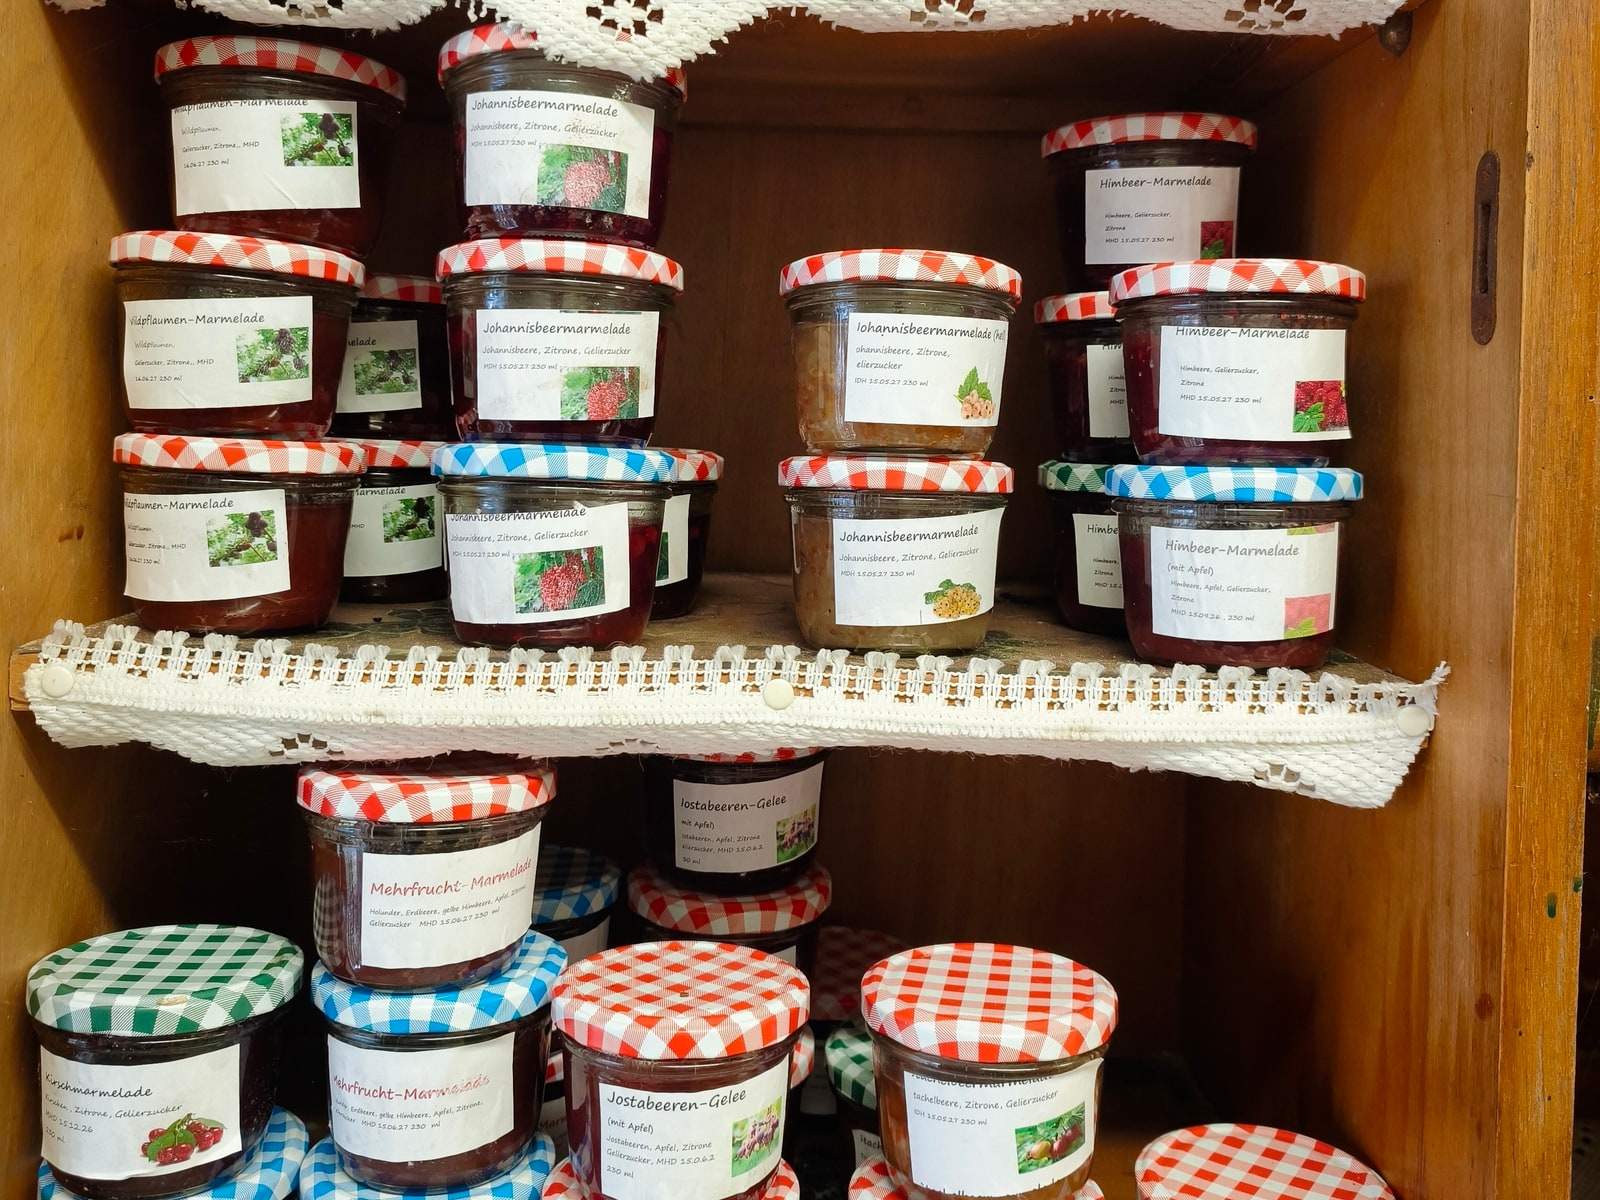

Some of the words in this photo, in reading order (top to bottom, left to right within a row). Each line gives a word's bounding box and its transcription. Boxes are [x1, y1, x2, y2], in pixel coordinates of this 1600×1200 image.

[472, 96, 619, 117] Johannisbeermarmelade
[524, 121, 561, 132] Zitrone,
[564, 123, 618, 138] Gelierzucker
[1100, 176, 1212, 189] Himbeer-Marmelade
[483, 322, 631, 335] Johannisbeermarmelade
[1176, 327, 1310, 339] Himbeer-Marmelade
[482, 344, 541, 356] Johannisbeere,
[544, 346, 581, 356] Zitrone,
[584, 346, 631, 355] Gelierzucker
[916, 347, 951, 358] Zitrone,
[197, 358, 214, 366] MHD
[903, 379, 918, 387] 230
[919, 379, 929, 387] ml
[1180, 379, 1204, 387] Zitrone
[1252, 396, 1262, 404] ml
[534, 529, 589, 541] Gelierzucker
[840, 524, 978, 543] Johannisbeermarmelade
[1165, 539, 1300, 556] Himbeer-Marmelade
[839, 553, 899, 563] Johannisbeere,
[902, 553, 936, 562] Zitrone,
[906, 569, 915, 577] ml
[1167, 562, 1185, 573] (mit
[1188, 565, 1214, 577] Apfel)
[1171, 608, 1186, 616] MHD
[442, 904, 460, 916] gelbe
[369, 920, 411, 928] Gelierzucker
[419, 920, 437, 928] MHD
[475, 911, 489, 920] 230
[46, 1071, 152, 1098] Kirschmarmelade
[607, 1089, 746, 1112] Jostabeeren-Gelee
[964, 1101, 1003, 1110] Zitrone,
[1005, 1091, 1058, 1109] Gelierzucker
[114, 1104, 183, 1118] Gelierzucker
[379, 1111, 394, 1121] gelbe
[361, 1120, 375, 1128] MHD
[607, 1116, 625, 1128] (mit
[628, 1121, 654, 1135] Apfel)
[978, 1118, 988, 1126] ml
[654, 1143, 679, 1154] Apfel,
[681, 1141, 712, 1152] Zitrone
[656, 1157, 677, 1166] MHD
[606, 1164, 622, 1175] 230
[623, 1170, 634, 1179] ml
